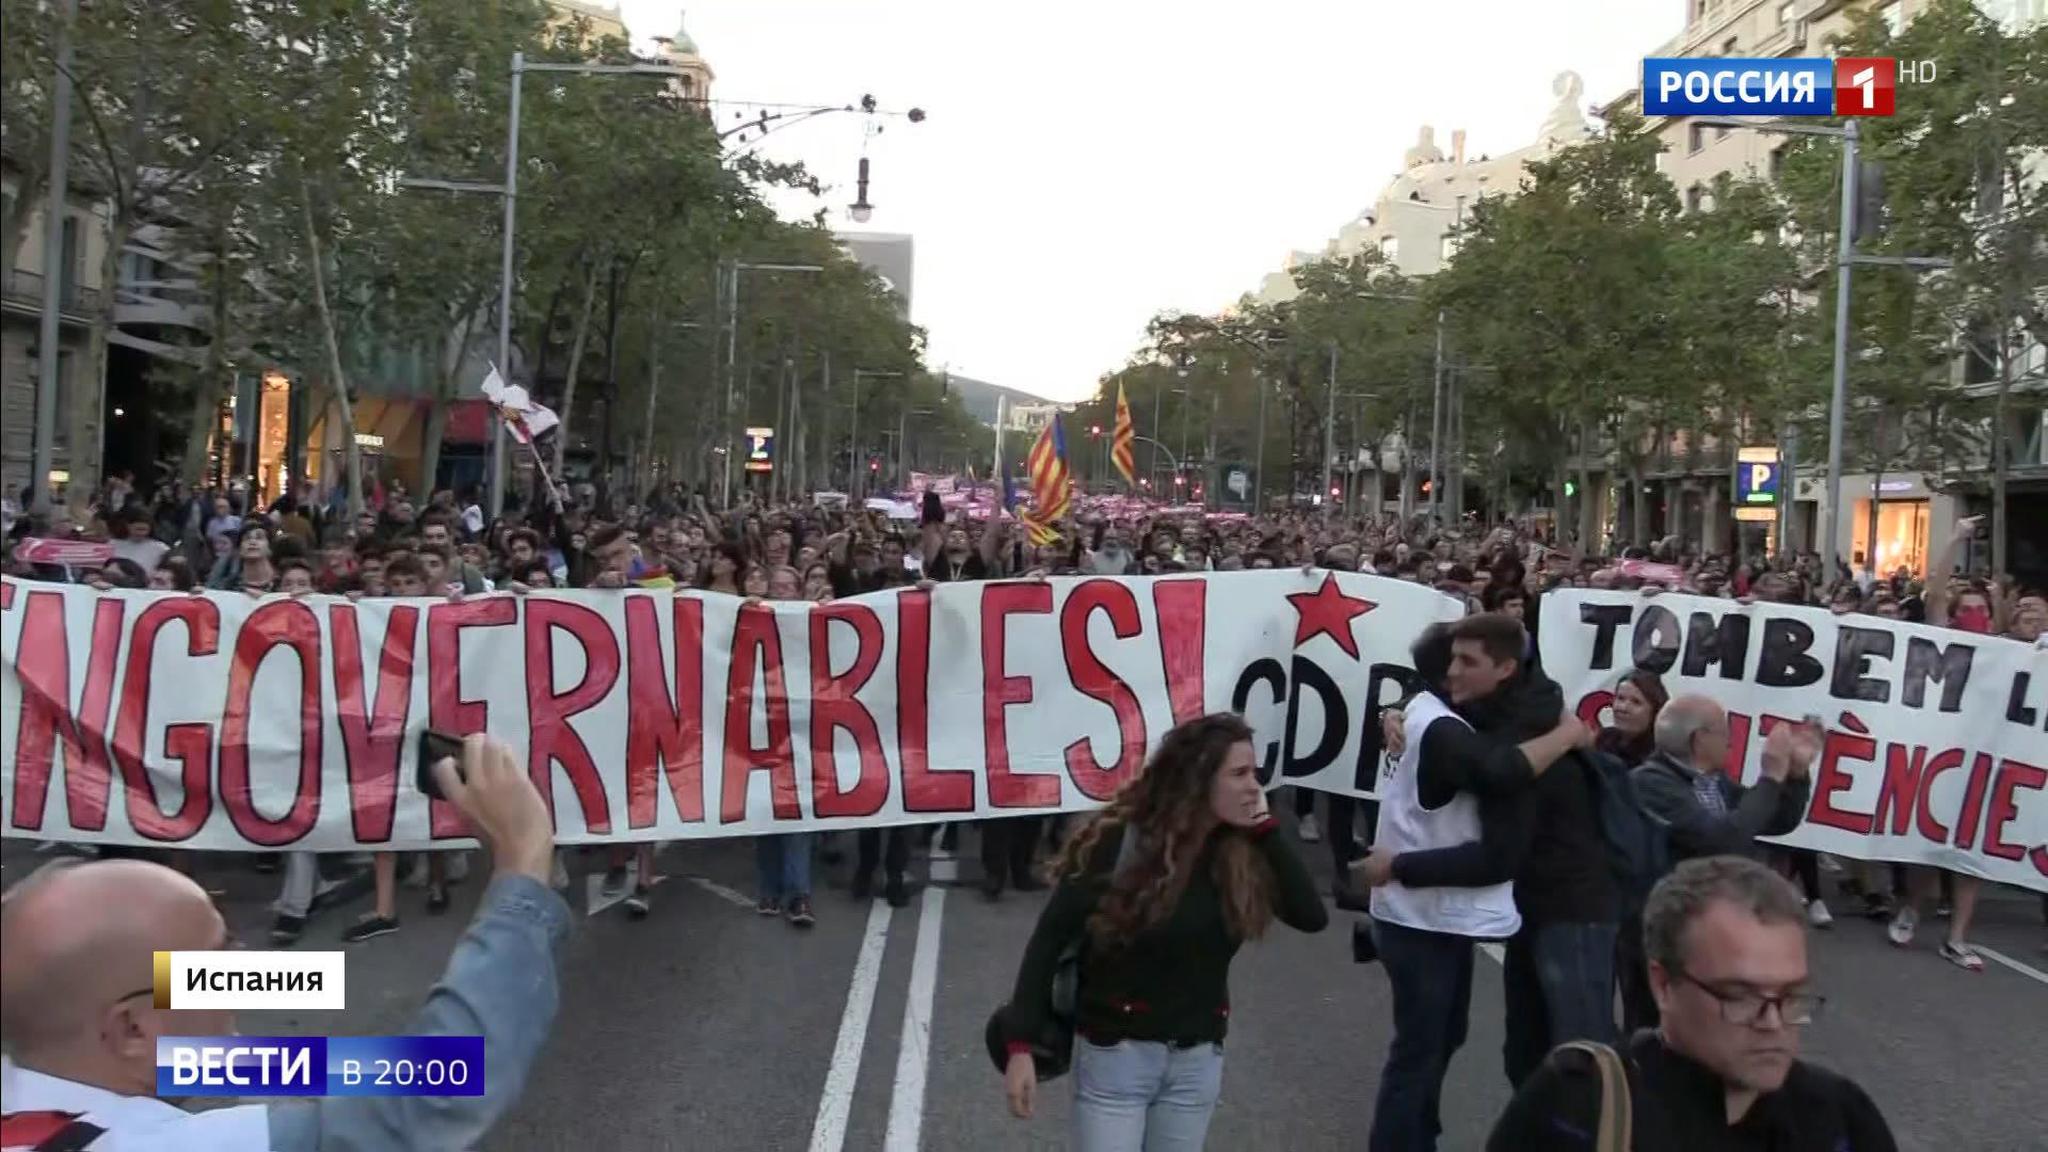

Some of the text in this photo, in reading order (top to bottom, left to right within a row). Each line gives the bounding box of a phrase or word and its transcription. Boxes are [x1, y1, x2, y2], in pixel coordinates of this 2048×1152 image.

[1752, 464, 1771, 491] P
[0, 577, 1207, 846] NGOVERNABLES!
[1579, 602, 2048, 734] TOMBEM L
